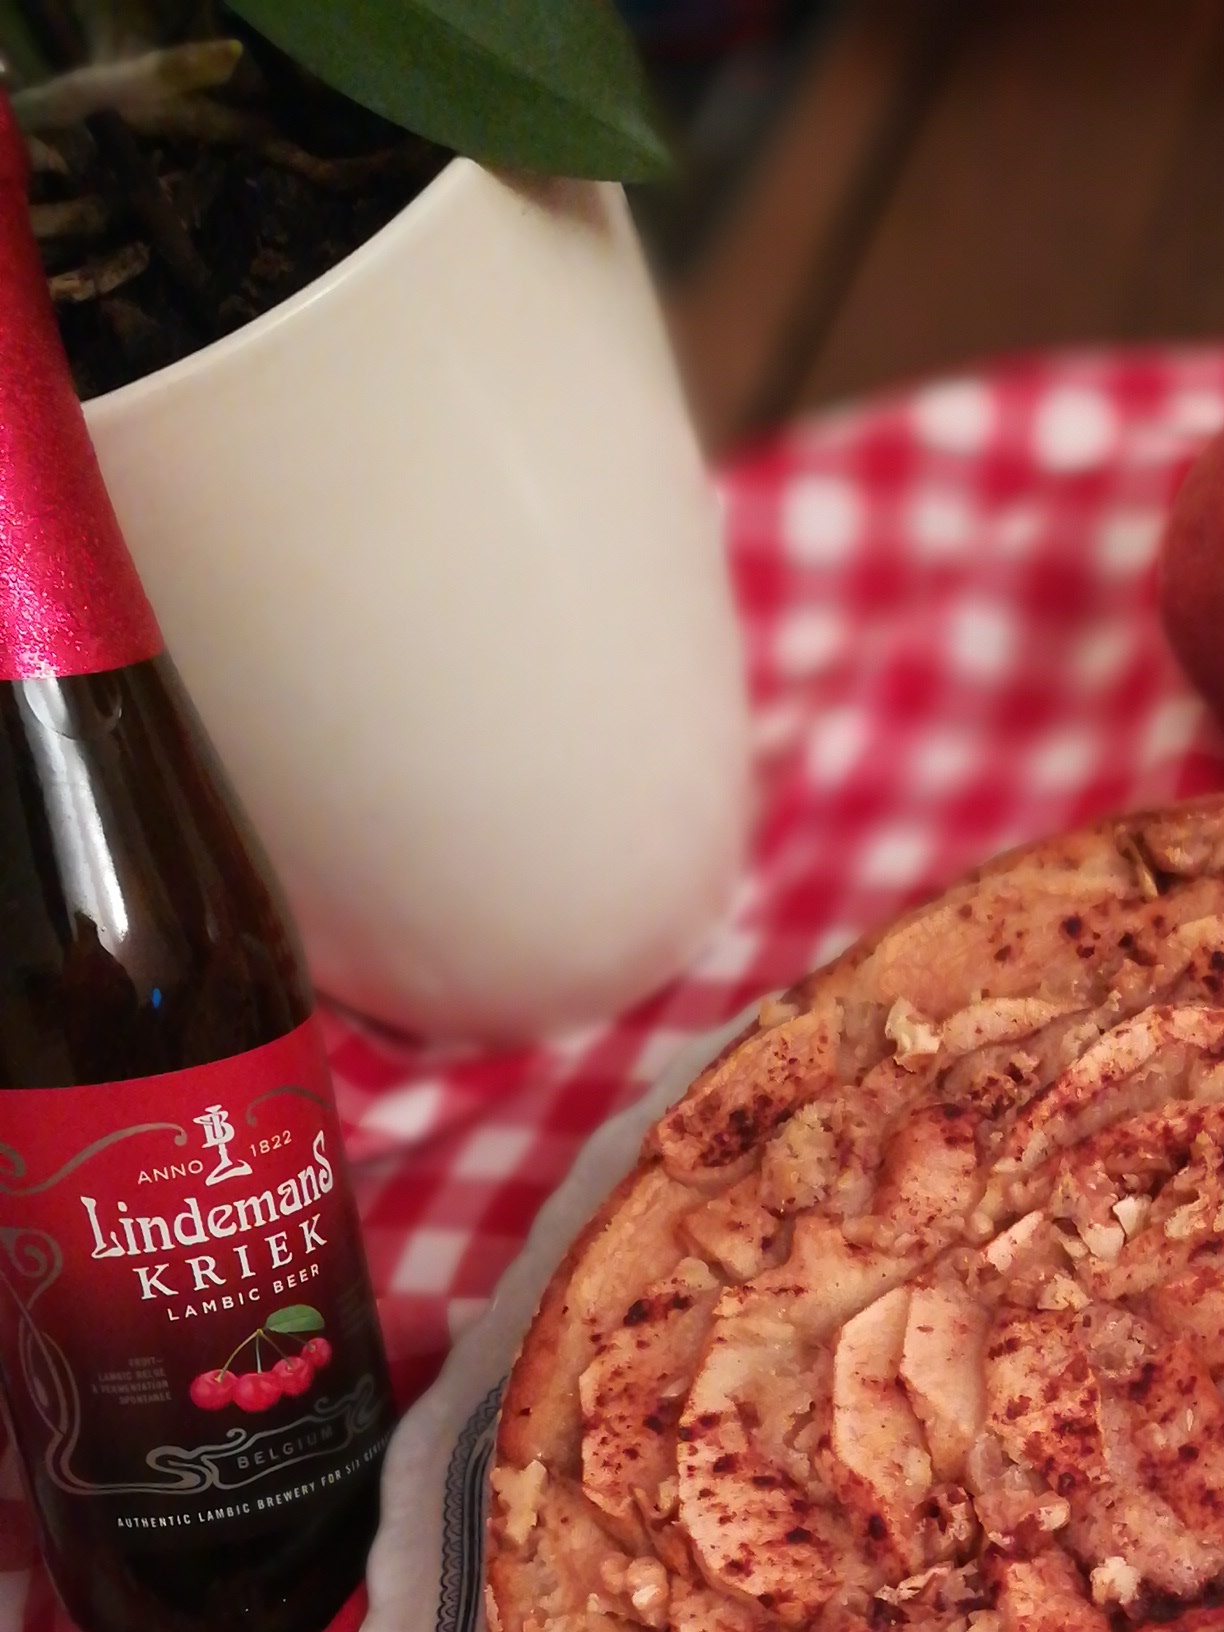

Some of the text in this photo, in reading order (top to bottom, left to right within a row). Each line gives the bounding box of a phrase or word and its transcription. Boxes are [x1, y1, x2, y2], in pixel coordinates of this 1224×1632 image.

[137, 1130, 293, 1185] ANNO 1822
[80, 1130, 335, 1260] Lindemans
[132, 1213, 329, 1301] KRIEK
[167, 1263, 321, 1322] LAMBIC BEER
[237, 1425, 335, 1471] BELGIUM
[115, 1513, 192, 1530] AUTHENTIC
[197, 1502, 252, 1524] LAMBIC
[256, 1480, 316, 1511] BREWERY
[320, 1469, 343, 1489] FOR
